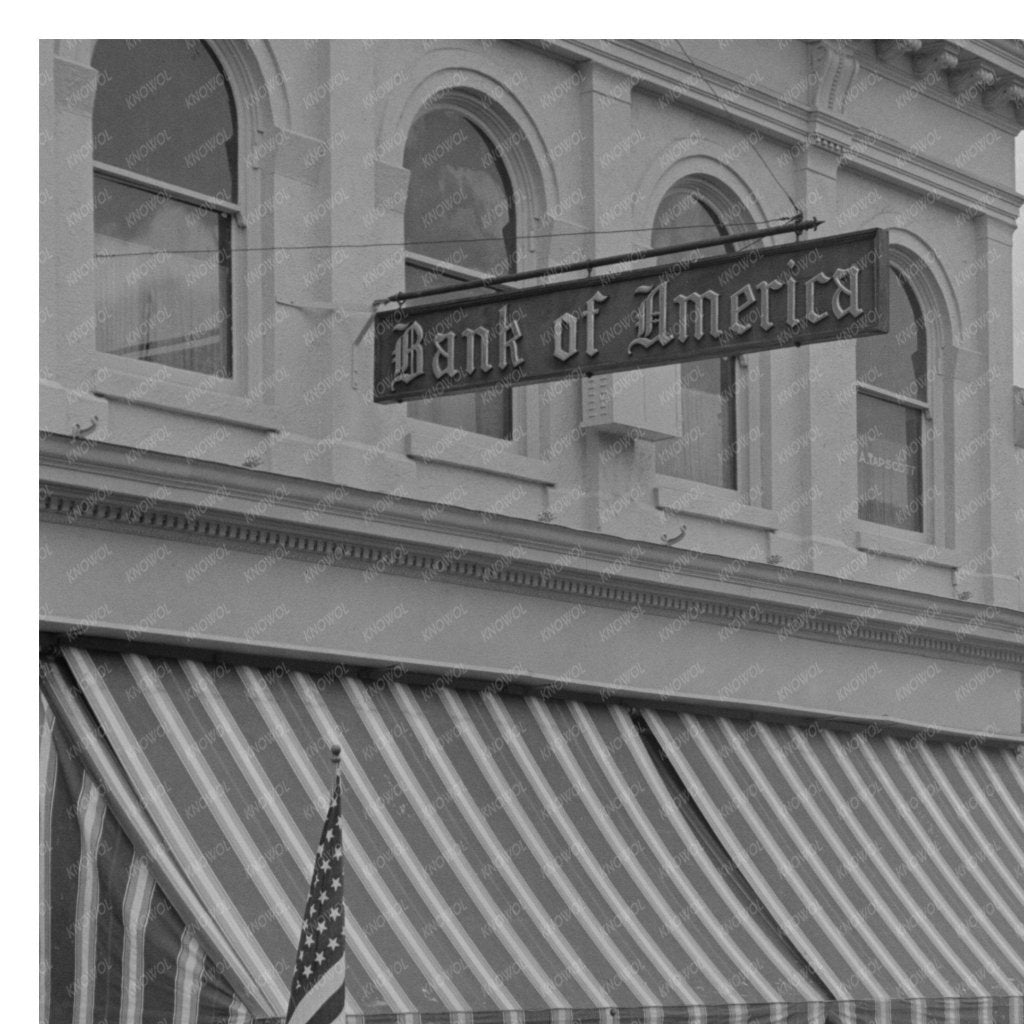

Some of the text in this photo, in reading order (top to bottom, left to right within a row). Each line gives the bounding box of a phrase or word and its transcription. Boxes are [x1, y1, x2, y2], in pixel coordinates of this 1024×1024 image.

[390, 259, 865, 392] Bank of America
